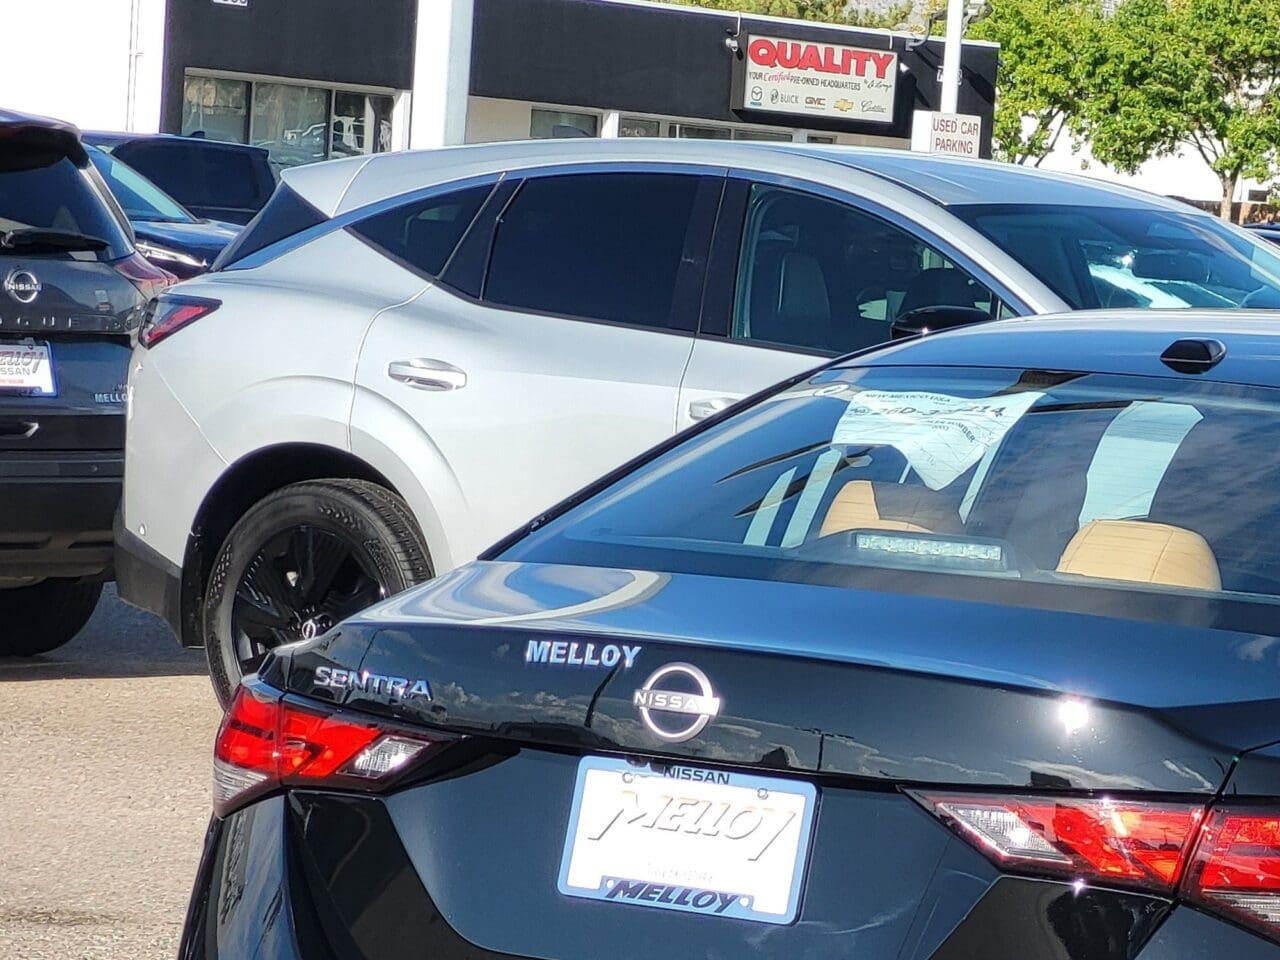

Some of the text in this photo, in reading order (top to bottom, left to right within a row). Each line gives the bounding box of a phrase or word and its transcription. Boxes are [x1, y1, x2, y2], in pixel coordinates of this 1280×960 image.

[749, 39, 894, 79] QUALITY
[820, 80, 861, 91] HEADQUARTERS
[780, 94, 799, 104] BUICK
[805, 96, 826, 106] GMC
[933, 118, 979, 137] USED CAR
[935, 138, 973, 154] PARKING
[526, 640, 642, 668] MELLOY
[313, 666, 434, 701] SENTRA
[662, 766, 731, 785] NISSAN
[588, 790, 796, 861] MELLOY
[604, 879, 740, 913] MELLOY
